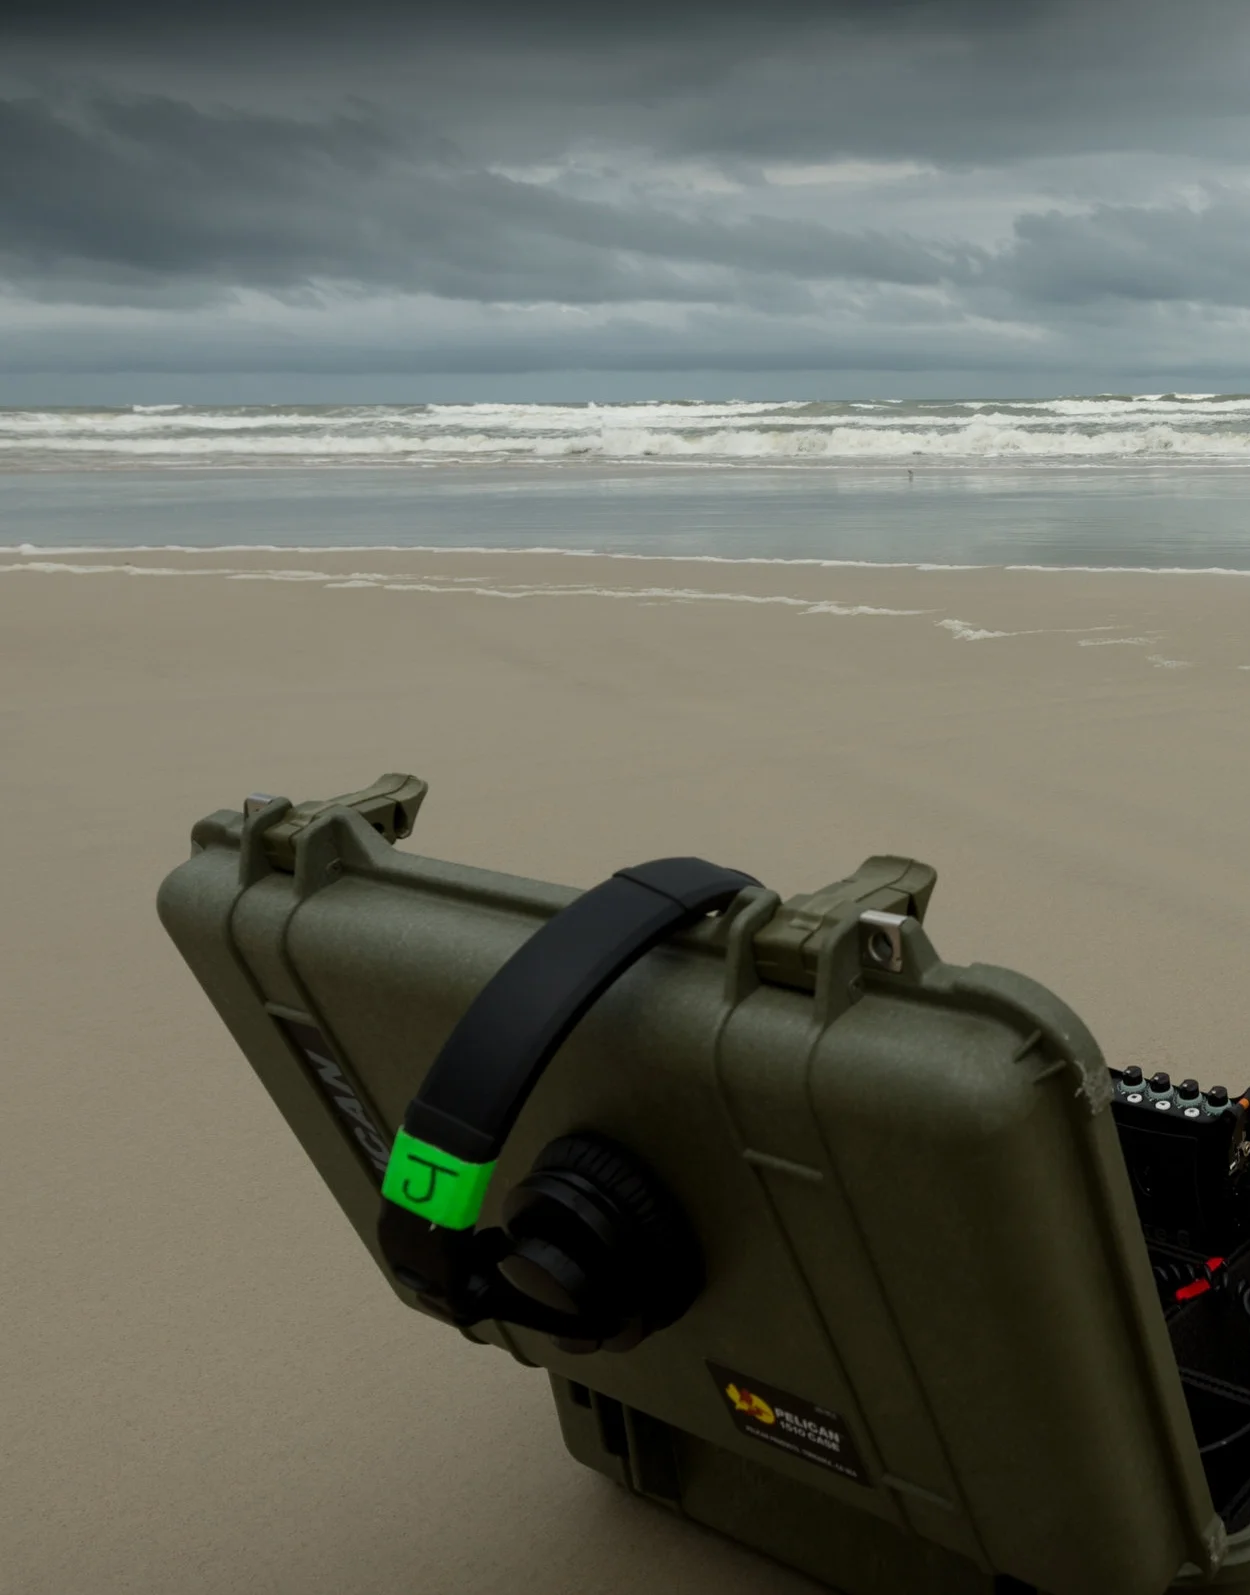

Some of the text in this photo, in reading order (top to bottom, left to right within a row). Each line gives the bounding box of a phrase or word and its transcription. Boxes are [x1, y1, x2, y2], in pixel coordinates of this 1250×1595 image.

[403, 1154, 459, 1203] J
[773, 1407, 841, 1443] PELICAN
[807, 1432, 841, 1452] CASE
